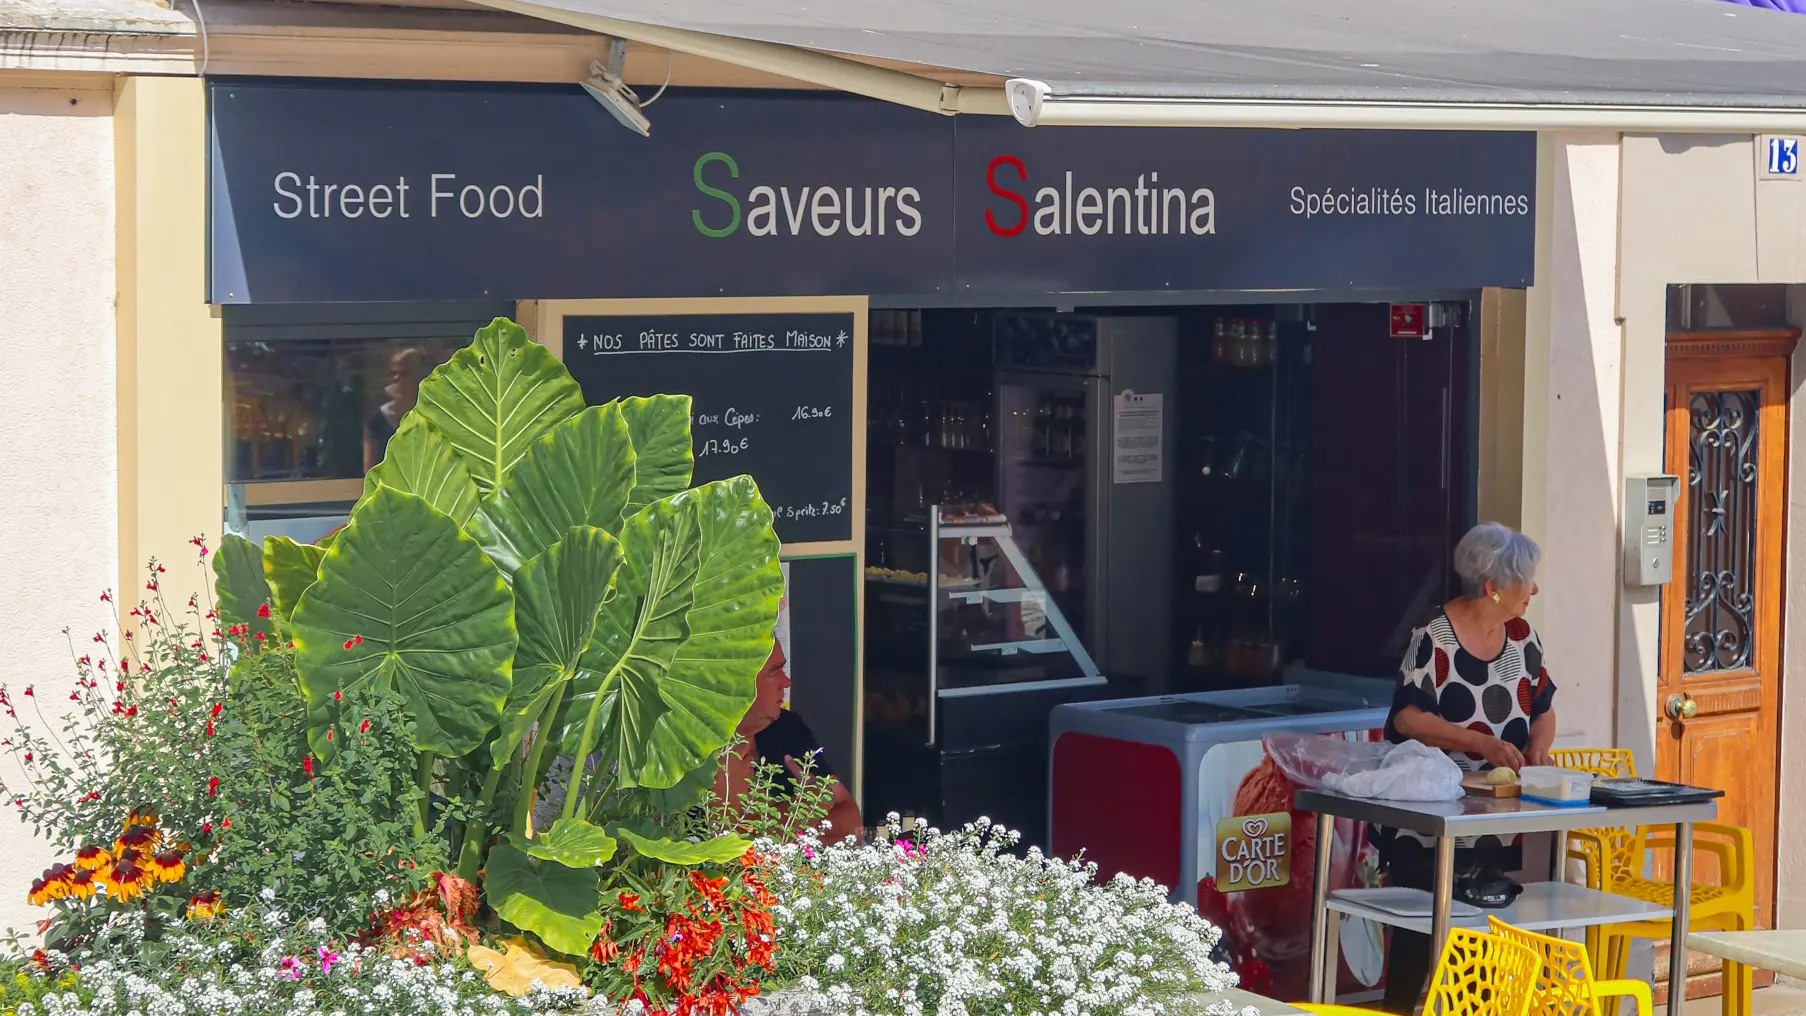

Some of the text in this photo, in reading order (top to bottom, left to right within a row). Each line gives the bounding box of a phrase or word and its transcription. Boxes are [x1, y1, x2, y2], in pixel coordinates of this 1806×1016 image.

[1770, 138, 1797, 173] 13
[273, 171, 543, 219] Street Food
[692, 151, 1216, 238] Saveurs Salentina
[1289, 186, 1529, 218] Spécialités Italiennes
[593, 333, 622, 350] NOS
[639, 329, 679, 349] PÂTES
[689, 333, 725, 349] SONT
[699, 414, 719, 425] aux
[791, 405, 832, 420] 16.90€
[699, 437, 749, 457] 17.90€
[1221, 833, 1285, 861] CARTE
[1229, 858, 1281, 885] D'OR
